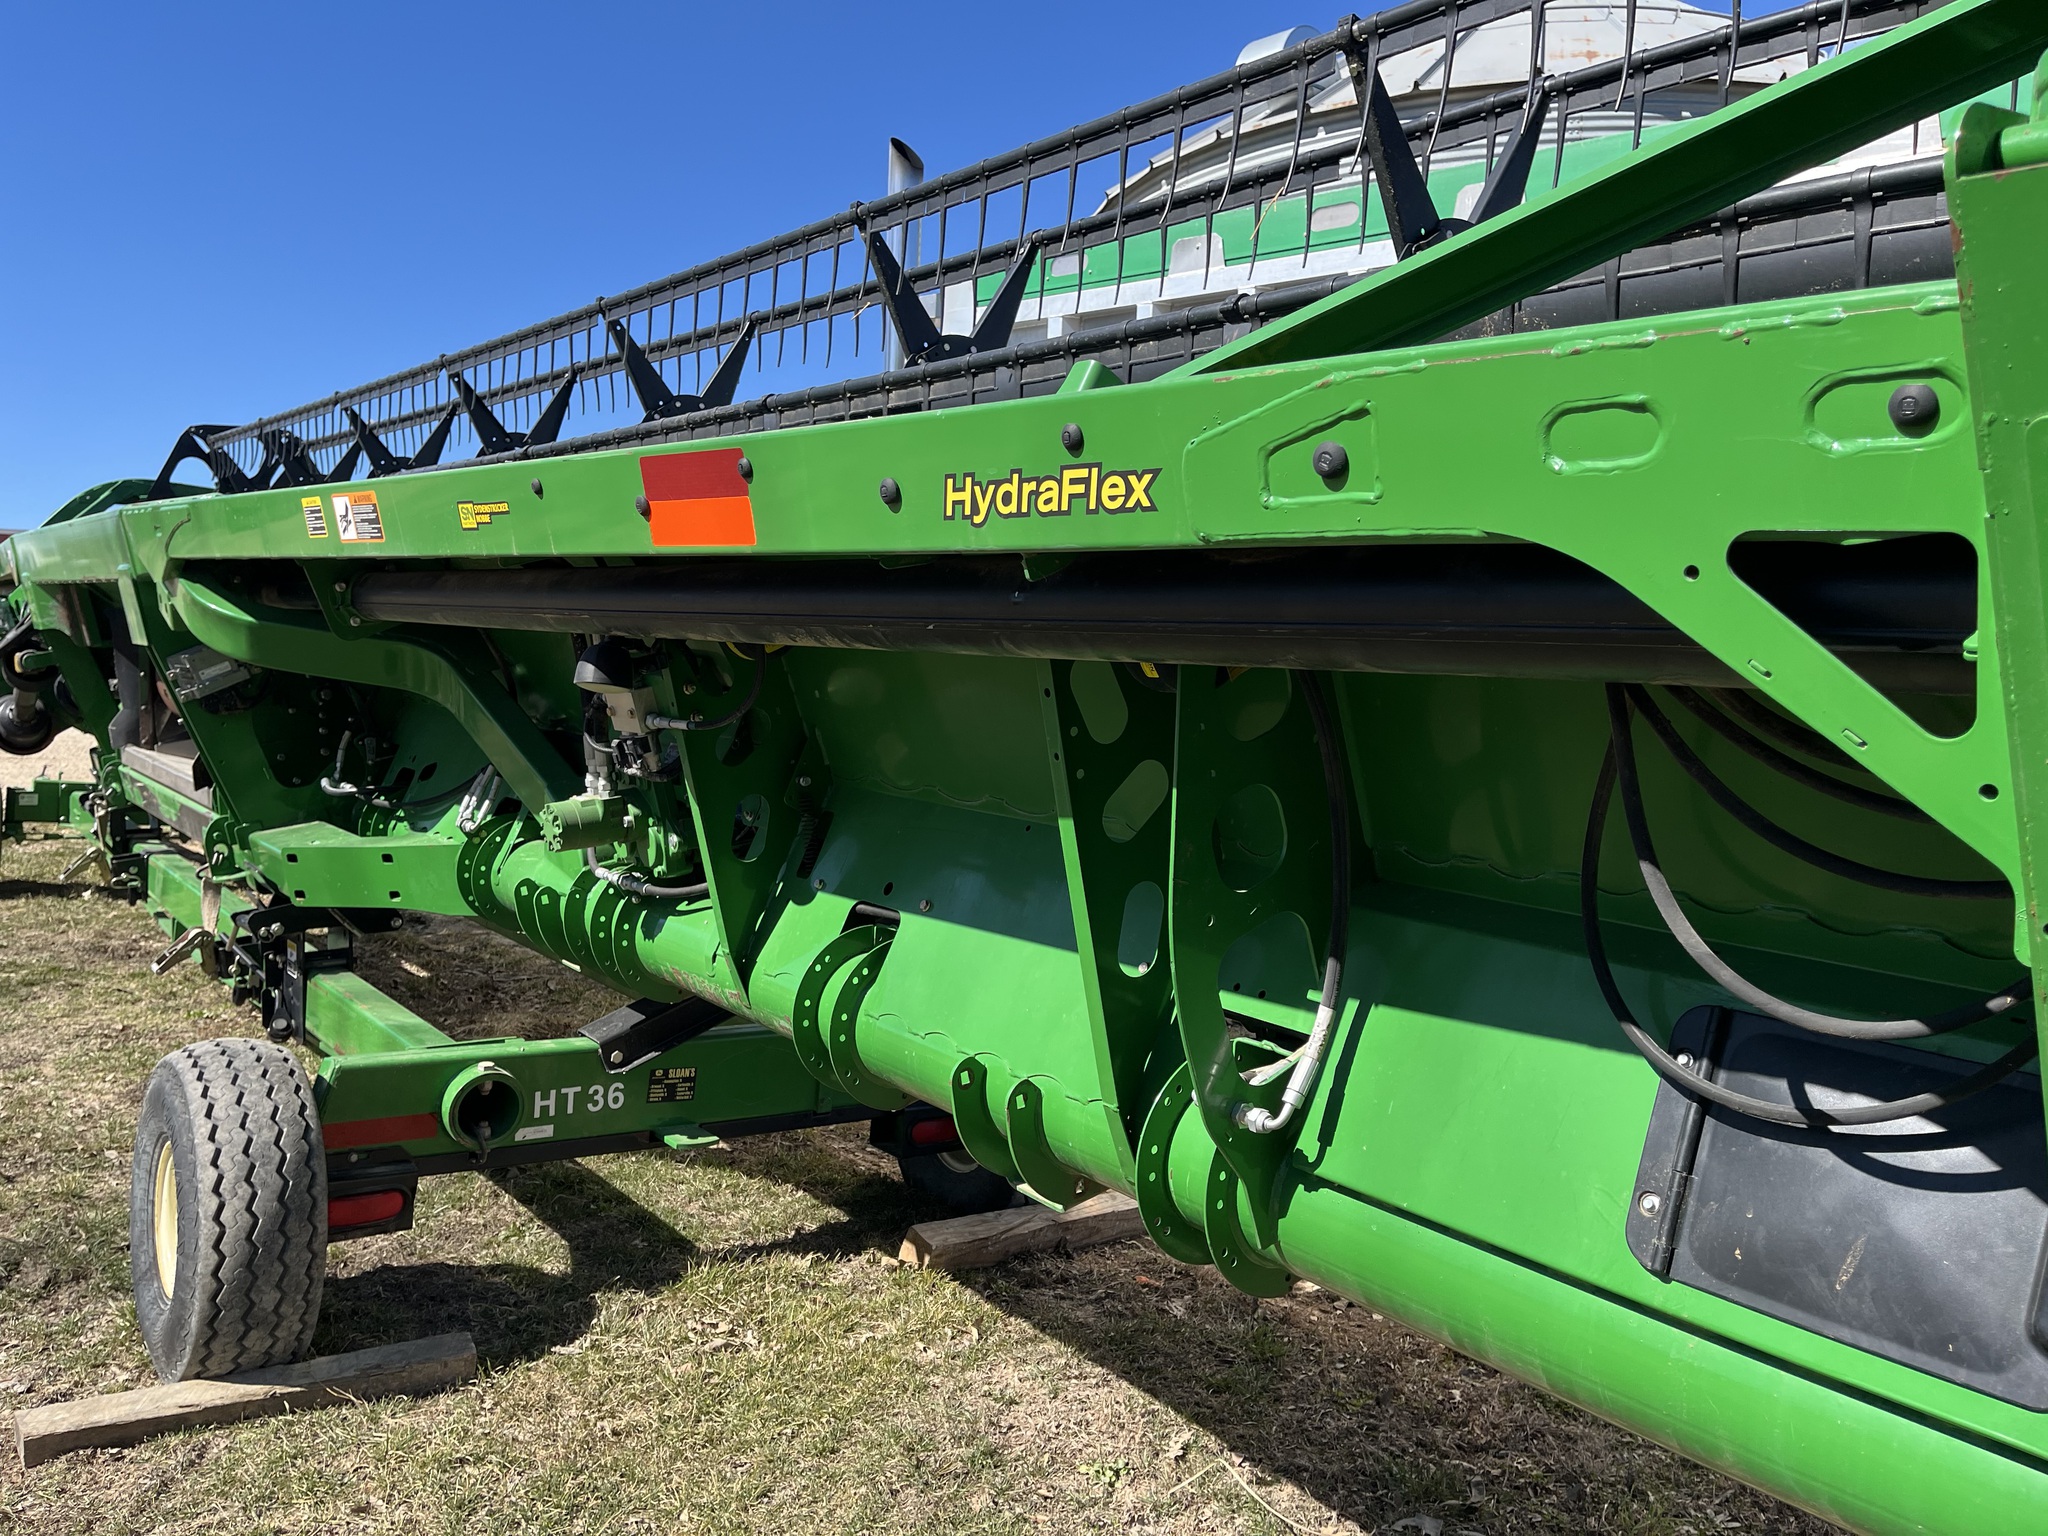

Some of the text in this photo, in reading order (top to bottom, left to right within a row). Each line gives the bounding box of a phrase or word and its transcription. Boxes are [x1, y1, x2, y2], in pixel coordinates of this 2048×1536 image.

[946, 467, 1154, 525] HydraFlex
[460, 505, 476, 521] SN
[668, 1067, 696, 1079] SLOAN'S
[533, 1086, 582, 1119] HT
[586, 1082, 625, 1112] 36
